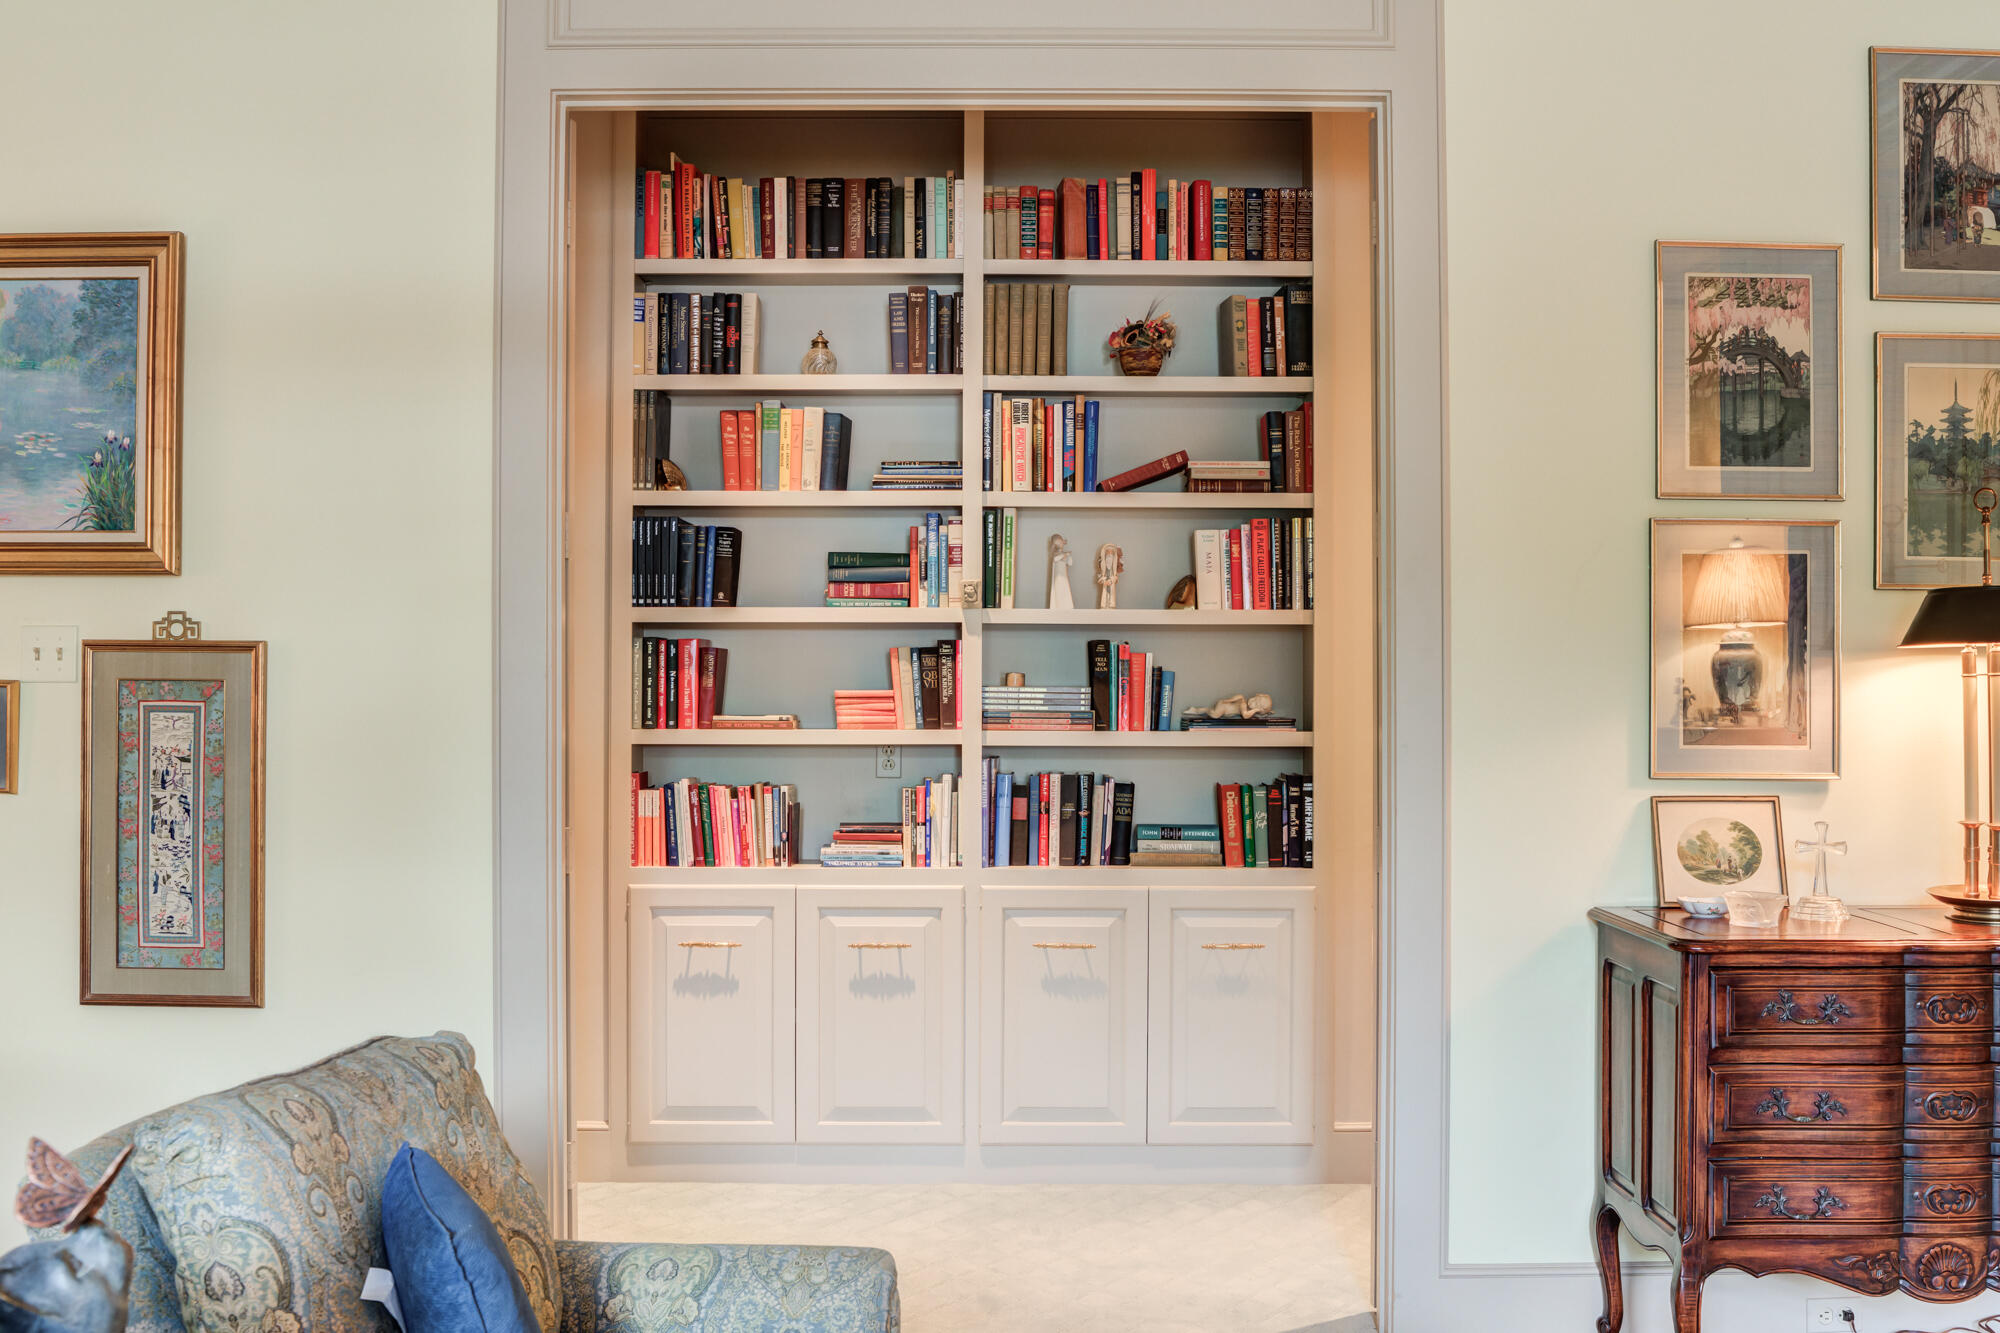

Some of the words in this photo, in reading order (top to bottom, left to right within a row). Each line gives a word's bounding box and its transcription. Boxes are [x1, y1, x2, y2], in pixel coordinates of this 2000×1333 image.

[850, 183, 858, 199] THE
[848, 203, 858, 252] JOURNEYER
[1021, 402, 1029, 424] ROBERT
[1066, 404, 1074, 418] RUSH
[1066, 419, 1074, 446] LIMBAUGH
[1017, 428, 1025, 462] APOCALYPSE
[1016, 462, 1025, 482] WATCH
[1257, 556, 1265, 576] CALLED
[1258, 577, 1266, 602] FREEDOM
[922, 671, 938, 679] QB
[923, 680, 938, 688] VII
[1115, 807, 1132, 815] ADA
[1226, 792, 1236, 838] Detective
[1304, 796, 1312, 842] AIRFRAME
[1160, 843, 1192, 851] STONEWALL
